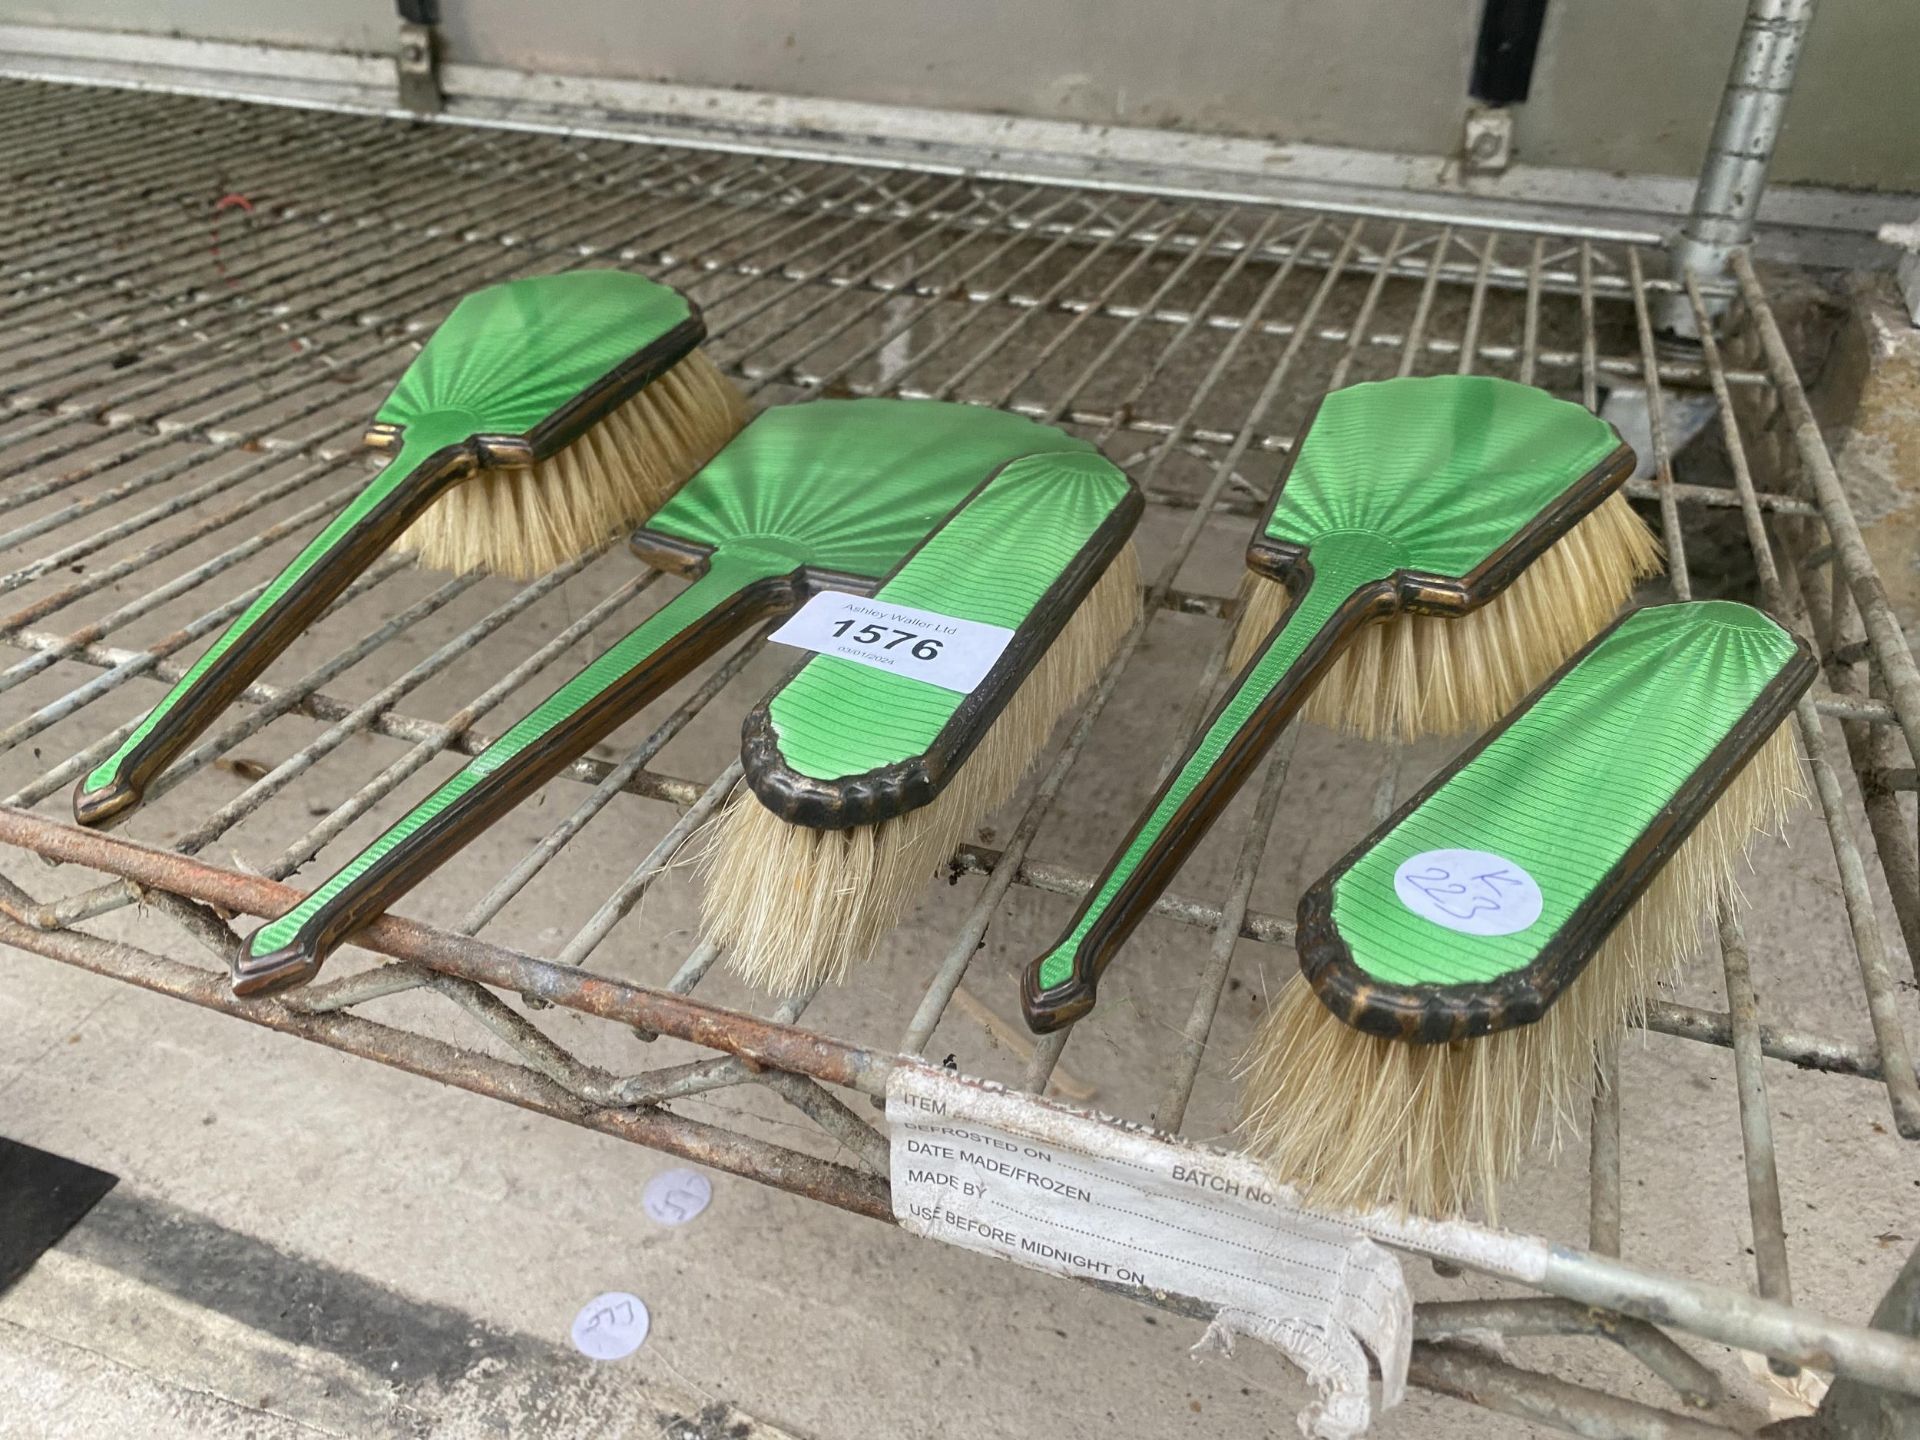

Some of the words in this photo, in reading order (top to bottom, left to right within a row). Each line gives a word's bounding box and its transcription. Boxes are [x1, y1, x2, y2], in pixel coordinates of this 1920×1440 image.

[831, 618, 944, 661] 1576
[844, 603, 886, 619] Ashley
[890, 613, 932, 629] Waller
[935, 623, 957, 636] Ltd
[837, 646, 895, 666] 03/01/2024
[904, 1122, 1018, 1153] DEFROSTED
[1023, 1147, 1052, 1163] ON
[904, 1094, 947, 1116] ITEM
[1171, 1164, 1240, 1196] BATCH
[907, 1139, 955, 1160] DATE
[959, 1150, 1091, 1203] MADE/FROZEN
[908, 1169, 960, 1190] MADE
[963, 1182, 988, 1199] BY
[909, 1203, 941, 1221] USE
[945, 1211, 1017, 1247] BEFORE
[1020, 1237, 1113, 1276] MIDNIGHT
[1116, 1268, 1145, 1286] ON
